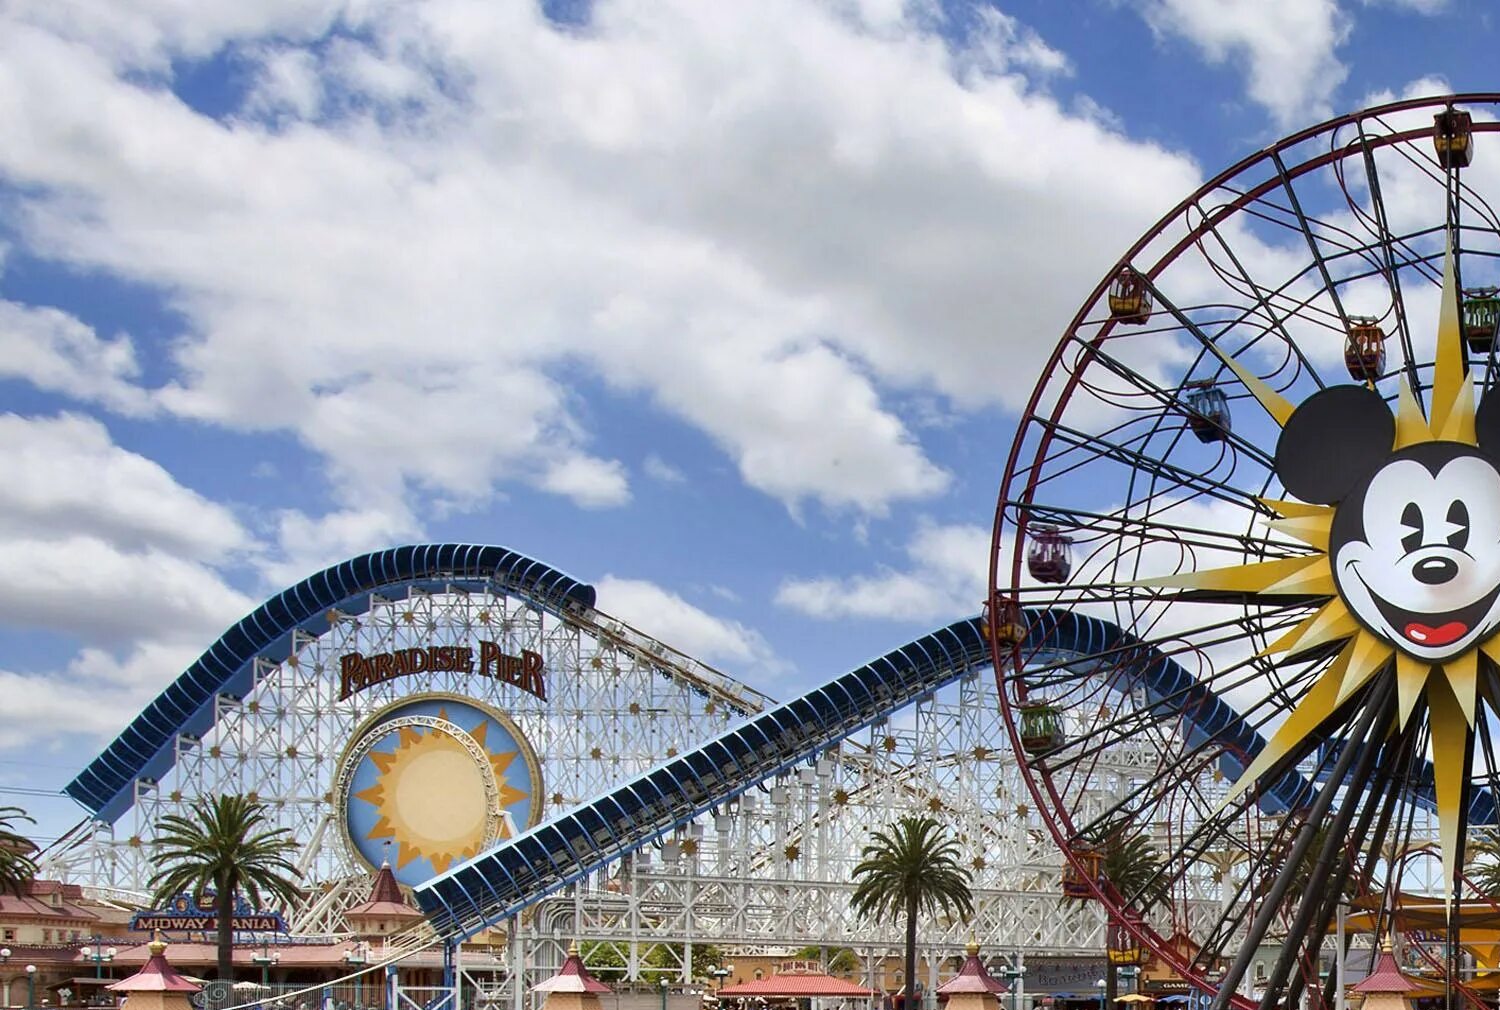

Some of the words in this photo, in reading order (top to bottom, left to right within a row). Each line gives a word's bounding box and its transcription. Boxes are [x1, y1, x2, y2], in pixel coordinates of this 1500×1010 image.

[339, 645, 474, 702] PARADISE
[478, 640, 548, 703] PIER
[138, 918, 209, 929] MIDWAY
